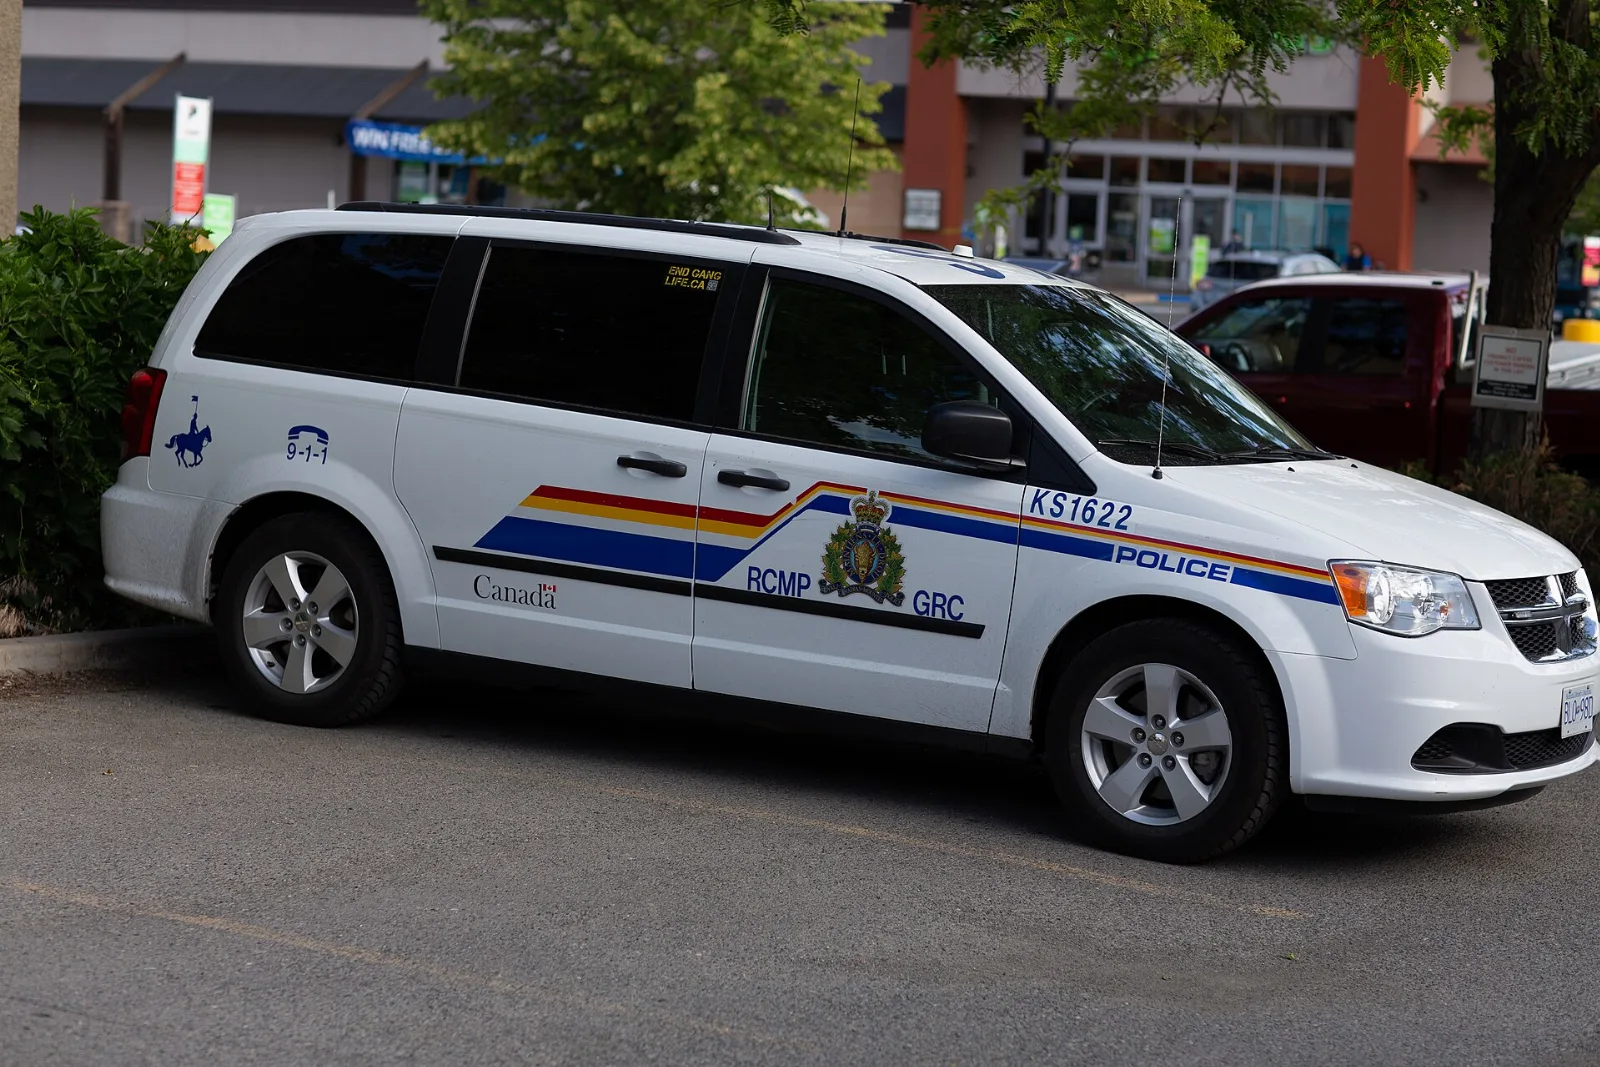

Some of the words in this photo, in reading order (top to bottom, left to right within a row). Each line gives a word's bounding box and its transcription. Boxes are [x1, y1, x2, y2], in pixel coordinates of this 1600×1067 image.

[665, 276, 705, 290] LIFE.CA
[668, 266, 690, 277] END
[691, 268, 722, 281] GANG
[287, 442, 328, 465] 9-1-1
[1029, 488, 1133, 531] KS1622
[1115, 545, 1231, 583] POLICE
[473, 574, 557, 610] Canada
[747, 565, 812, 598] RCMP
[912, 589, 965, 621] GRC
